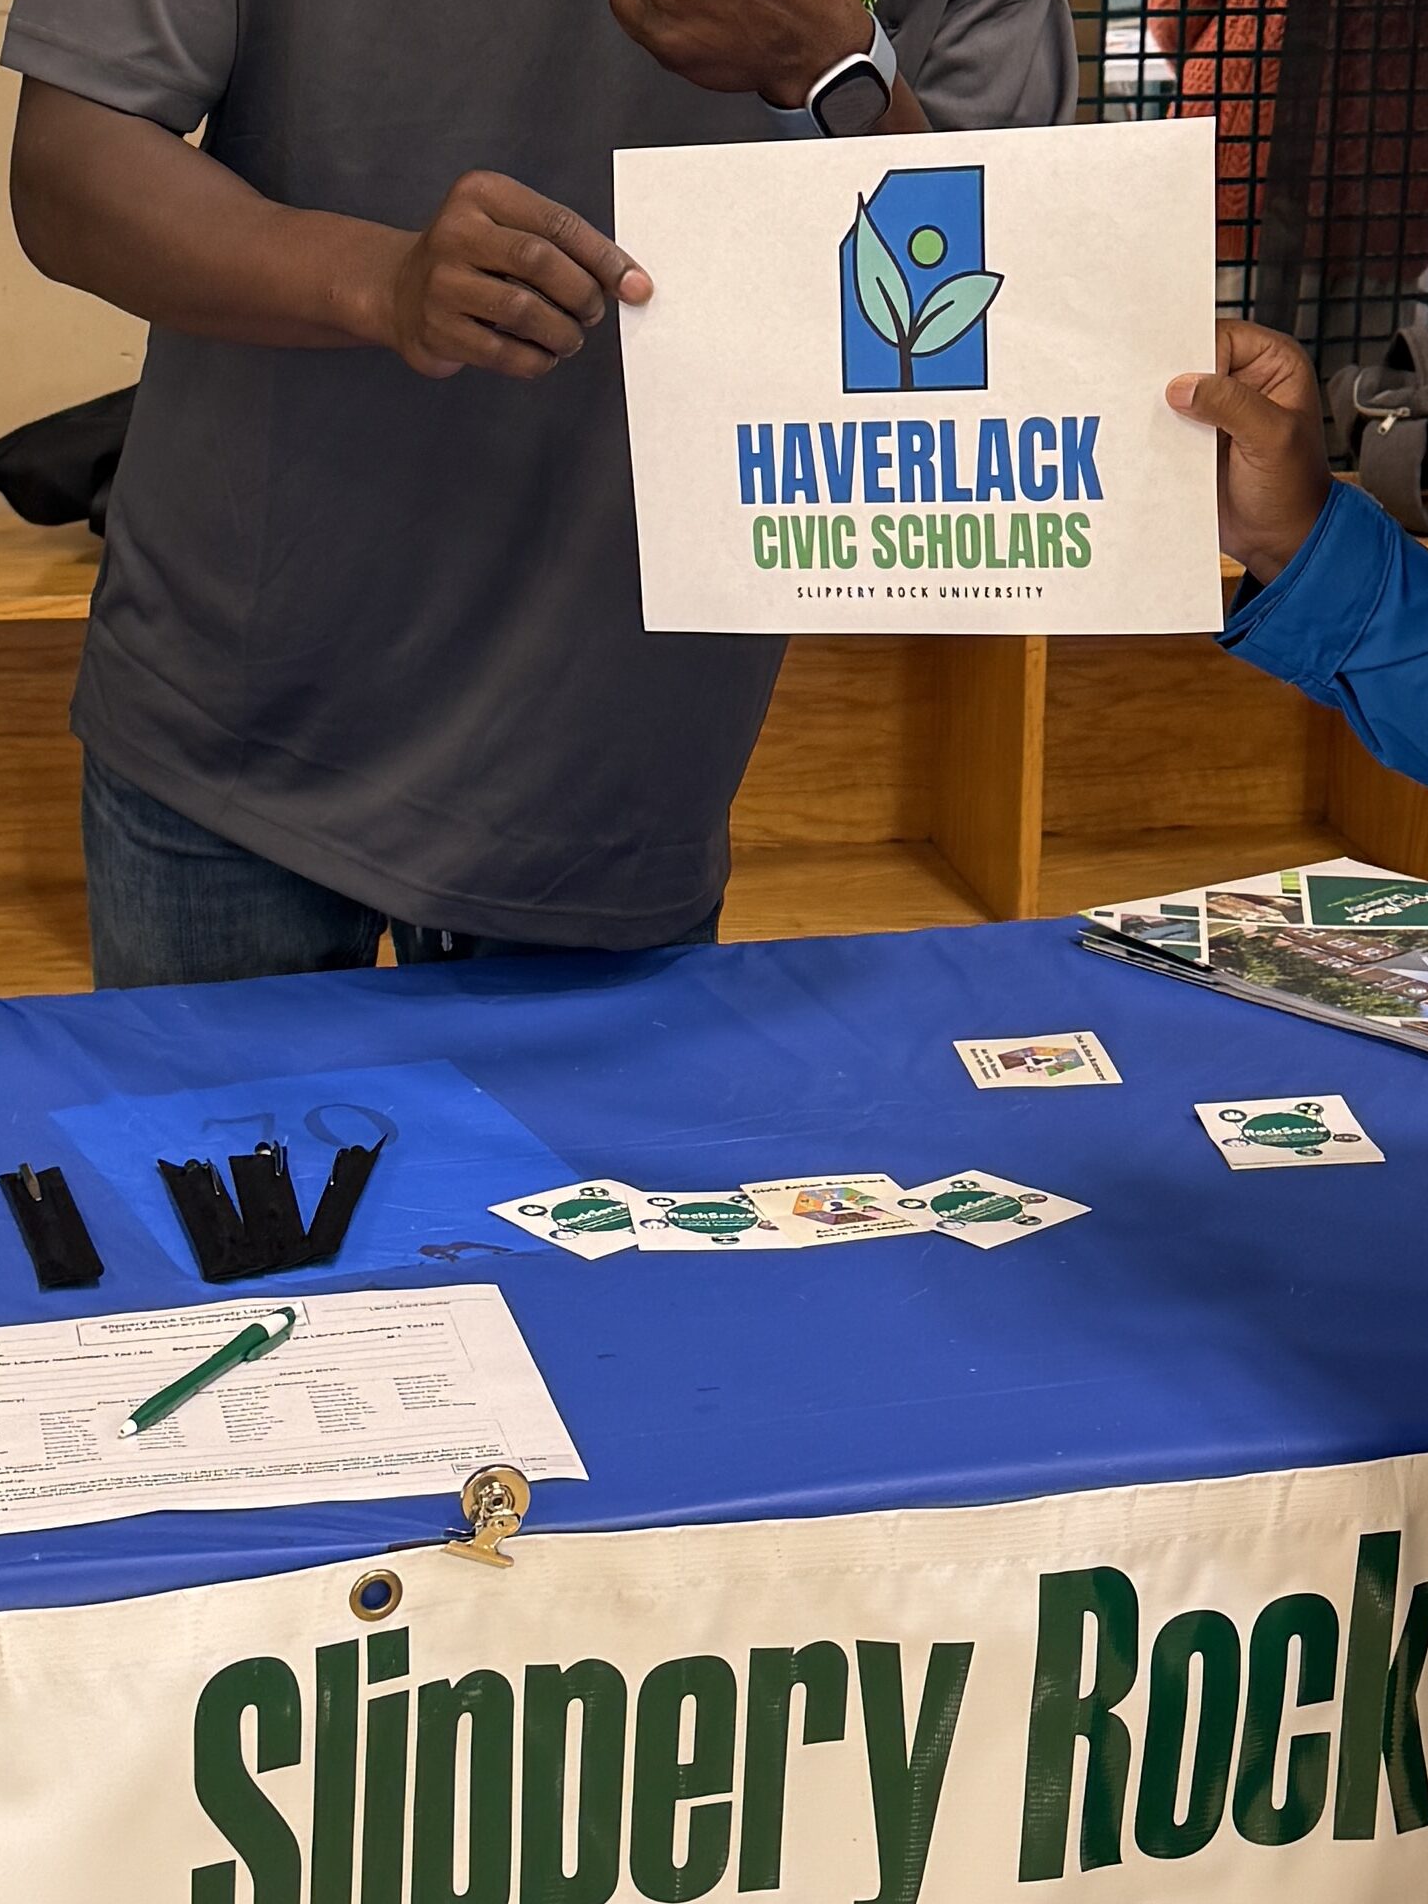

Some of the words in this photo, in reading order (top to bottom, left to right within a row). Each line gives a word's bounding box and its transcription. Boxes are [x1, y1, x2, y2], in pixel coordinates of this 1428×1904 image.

[736, 417, 1103, 504] HAVERLACK
[753, 515, 857, 569] CIVIC
[872, 513, 1091, 568] SCHOLARS
[797, 587, 874, 598] SLIPPERY
[887, 587, 928, 598] ROCK
[939, 586, 1043, 598] UNIVERSITY
